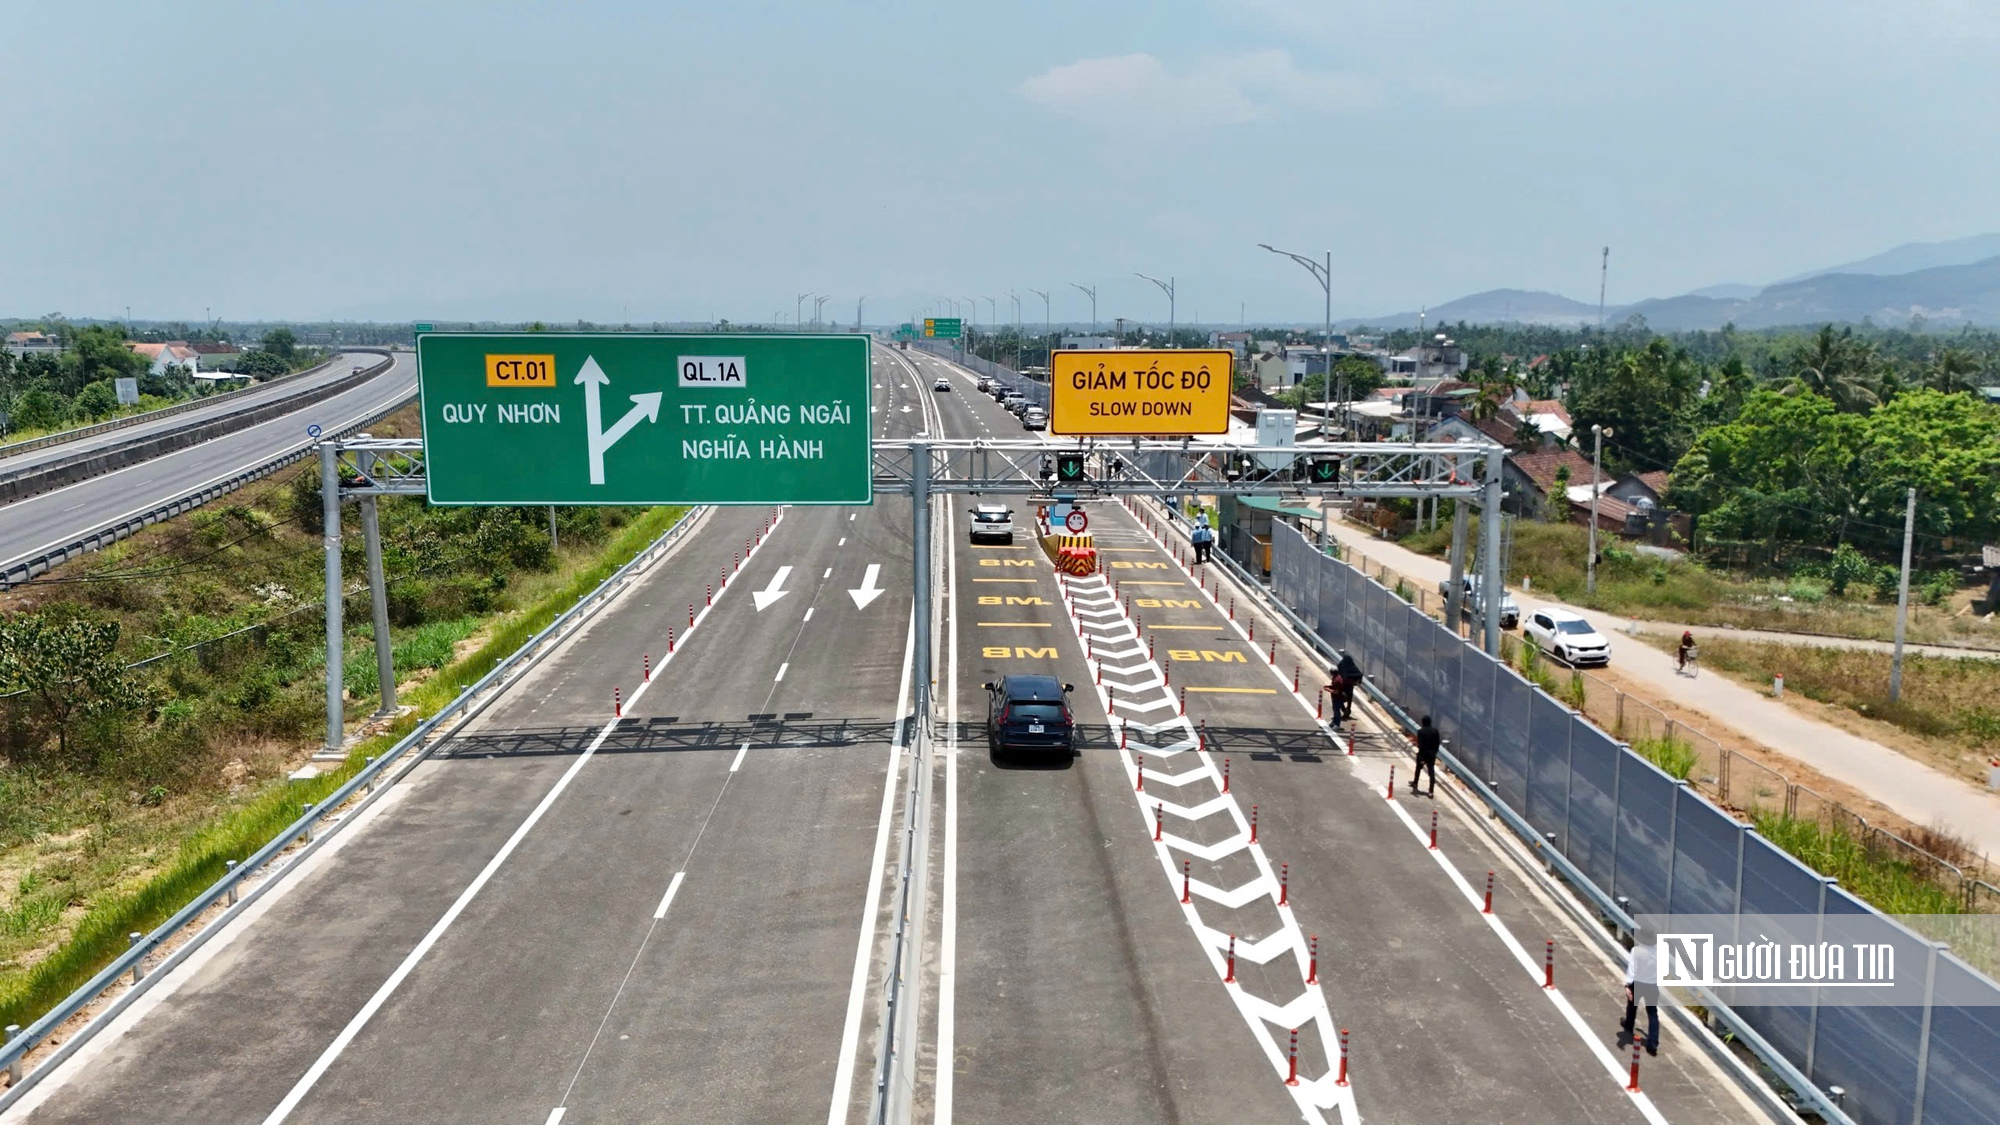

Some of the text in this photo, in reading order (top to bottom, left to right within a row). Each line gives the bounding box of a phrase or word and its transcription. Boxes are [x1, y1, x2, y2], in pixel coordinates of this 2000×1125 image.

[495, 361, 547, 381] CT.01
[683, 362, 741, 382] QL.1A
[1072, 361, 1211, 393] GIẢM TỐC ĐỘ
[442, 402, 561, 424] QUY NHƠN
[800, 399, 851, 424] NGÃI
[1089, 401, 1192, 416] SLOW DOWN
[682, 433, 824, 459] NGHĨA HÀNH
[979, 558, 1035, 567] 8M
[1110, 561, 1169, 570] 8M
[977, 596, 1044, 605] 8M
[1134, 598, 1203, 609] 8M
[982, 646, 1060, 659] 8M
[1166, 649, 1249, 663] 8M
